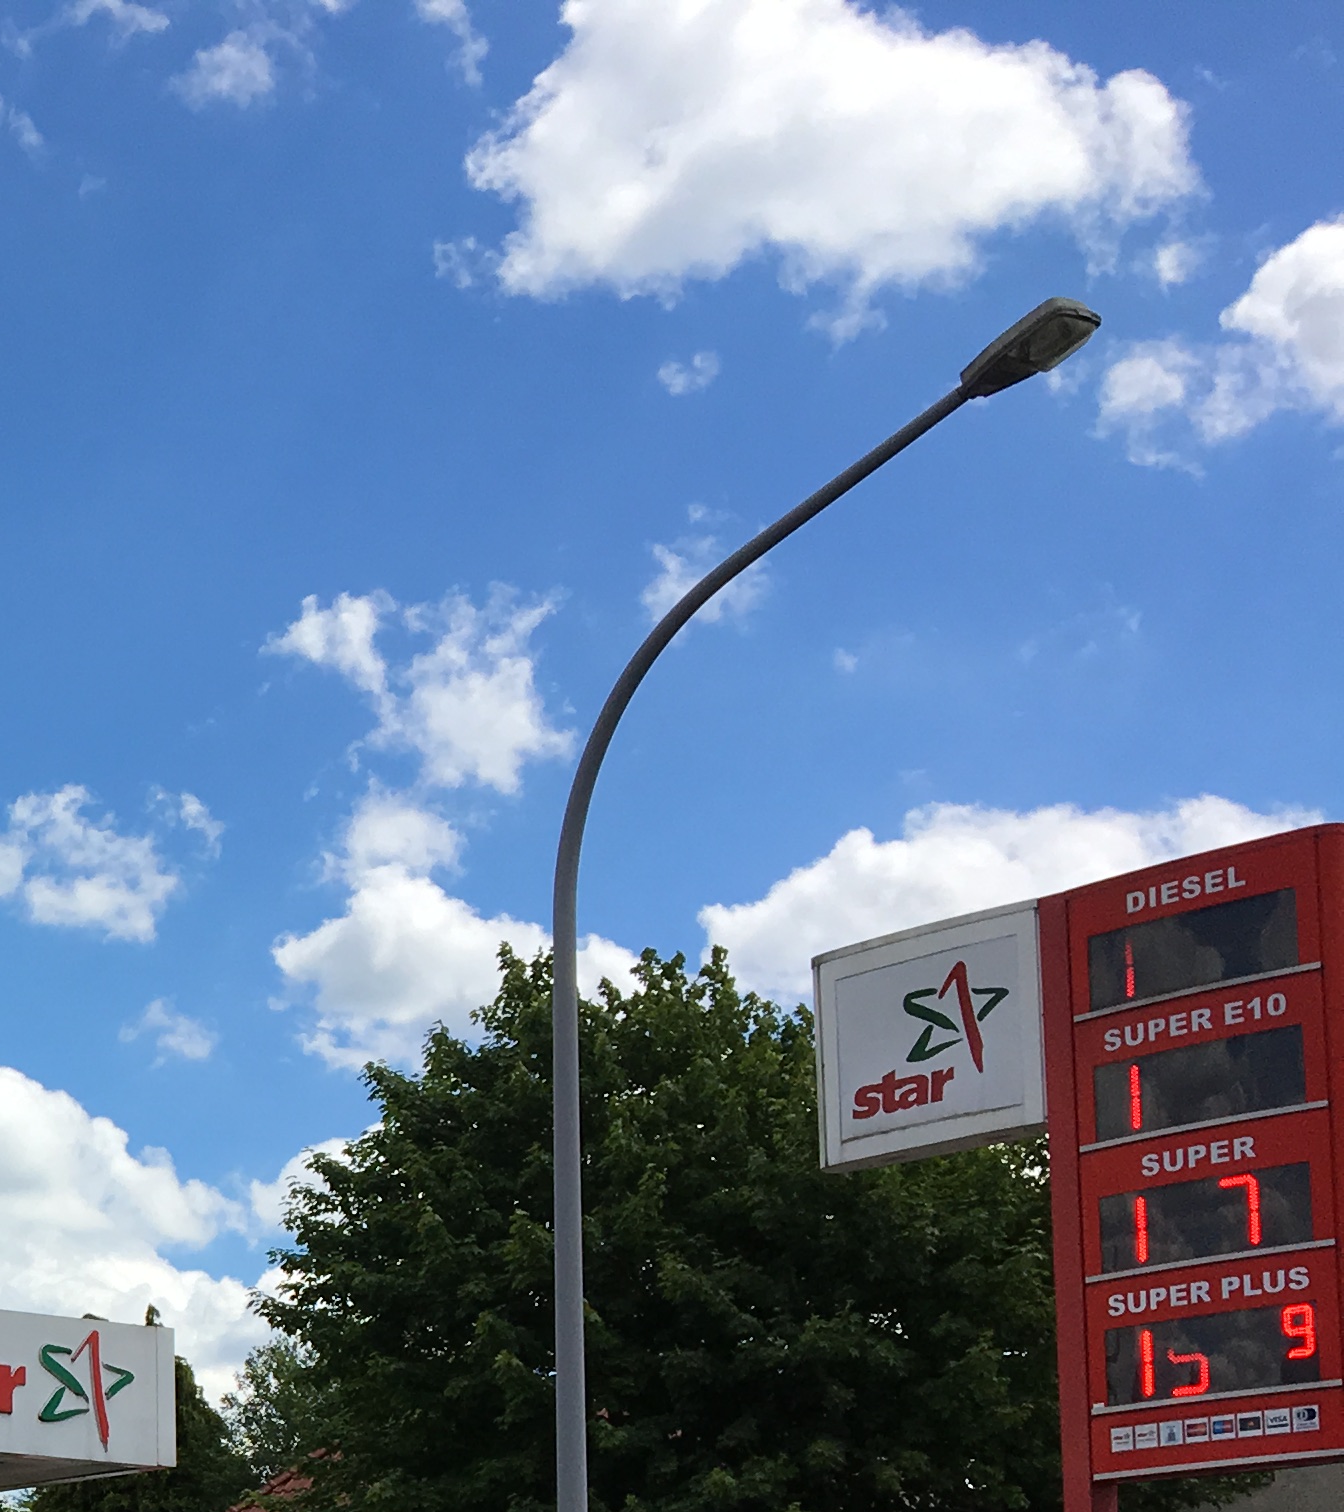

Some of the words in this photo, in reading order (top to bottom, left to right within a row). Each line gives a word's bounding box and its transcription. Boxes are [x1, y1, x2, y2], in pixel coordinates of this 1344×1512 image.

[1126, 866, 1246, 914] DIESEL
[1104, 1008, 1212, 1052] SUPER
[1224, 993, 1287, 1025] E10
[852, 1066, 955, 1120] star
[1141, 1136, 1256, 1177] SUPER
[1108, 1280, 1211, 1317] SUPER
[1221, 1266, 1310, 1300] PLUS
